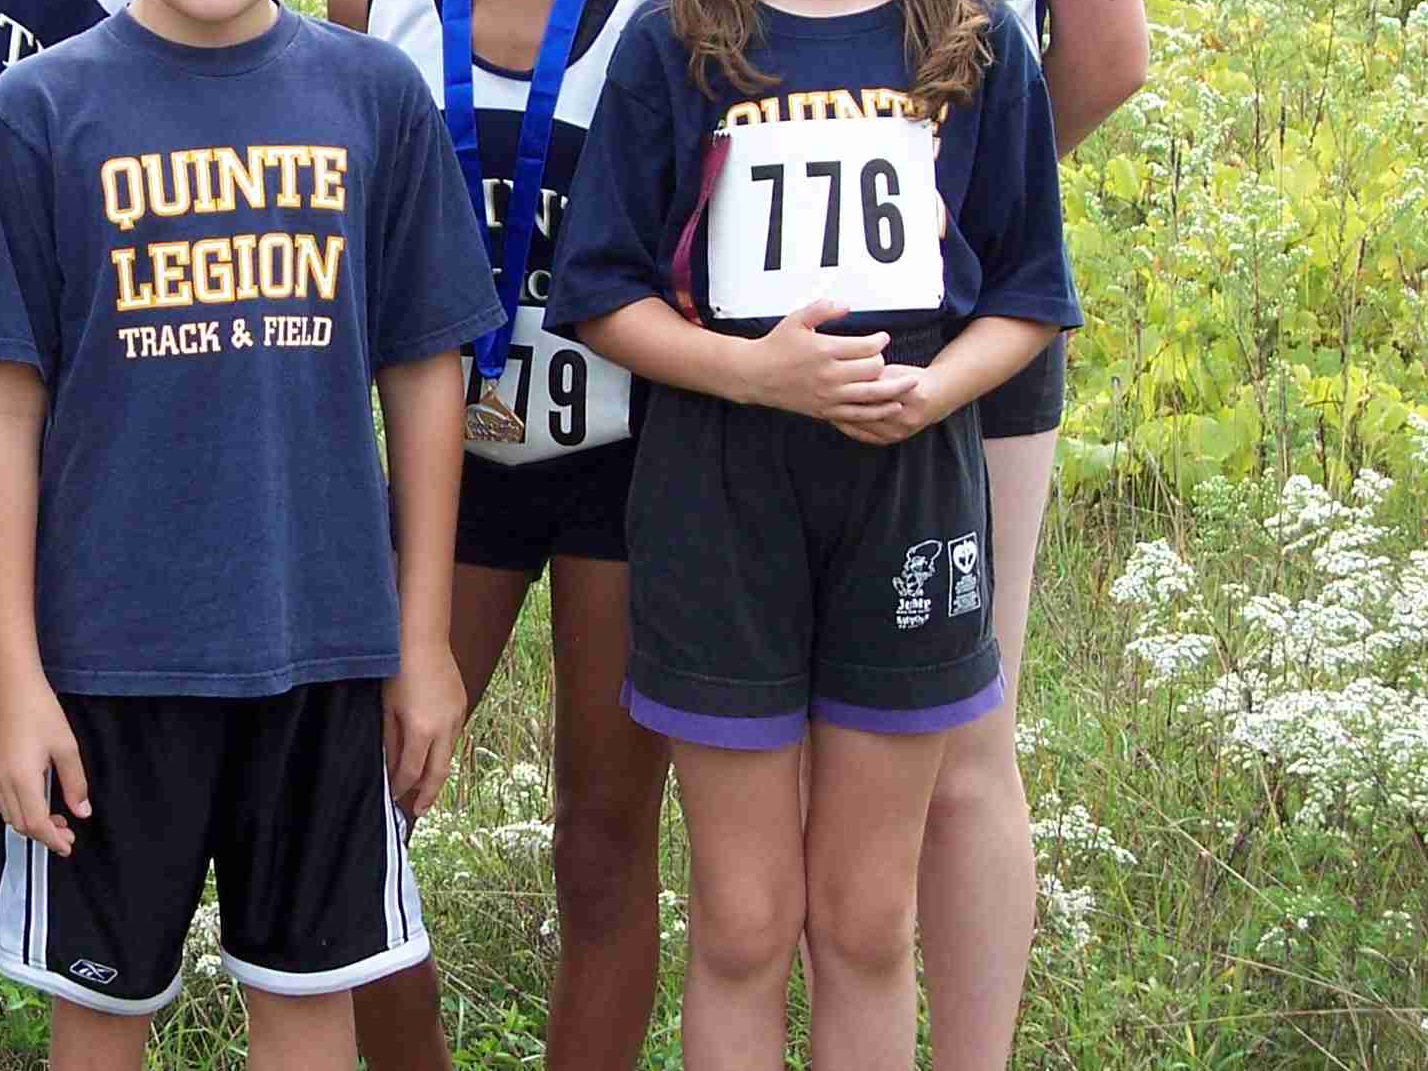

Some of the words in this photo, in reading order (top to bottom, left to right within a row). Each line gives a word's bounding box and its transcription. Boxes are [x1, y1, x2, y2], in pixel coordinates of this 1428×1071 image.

[100, 144, 348, 230] QUINTE
[751, 158, 905, 271] 776
[111, 232, 344, 311] LEGION
[118, 322, 221, 358] TRACK
[231, 318, 253, 349] &
[263, 315, 333, 347] FIELD
